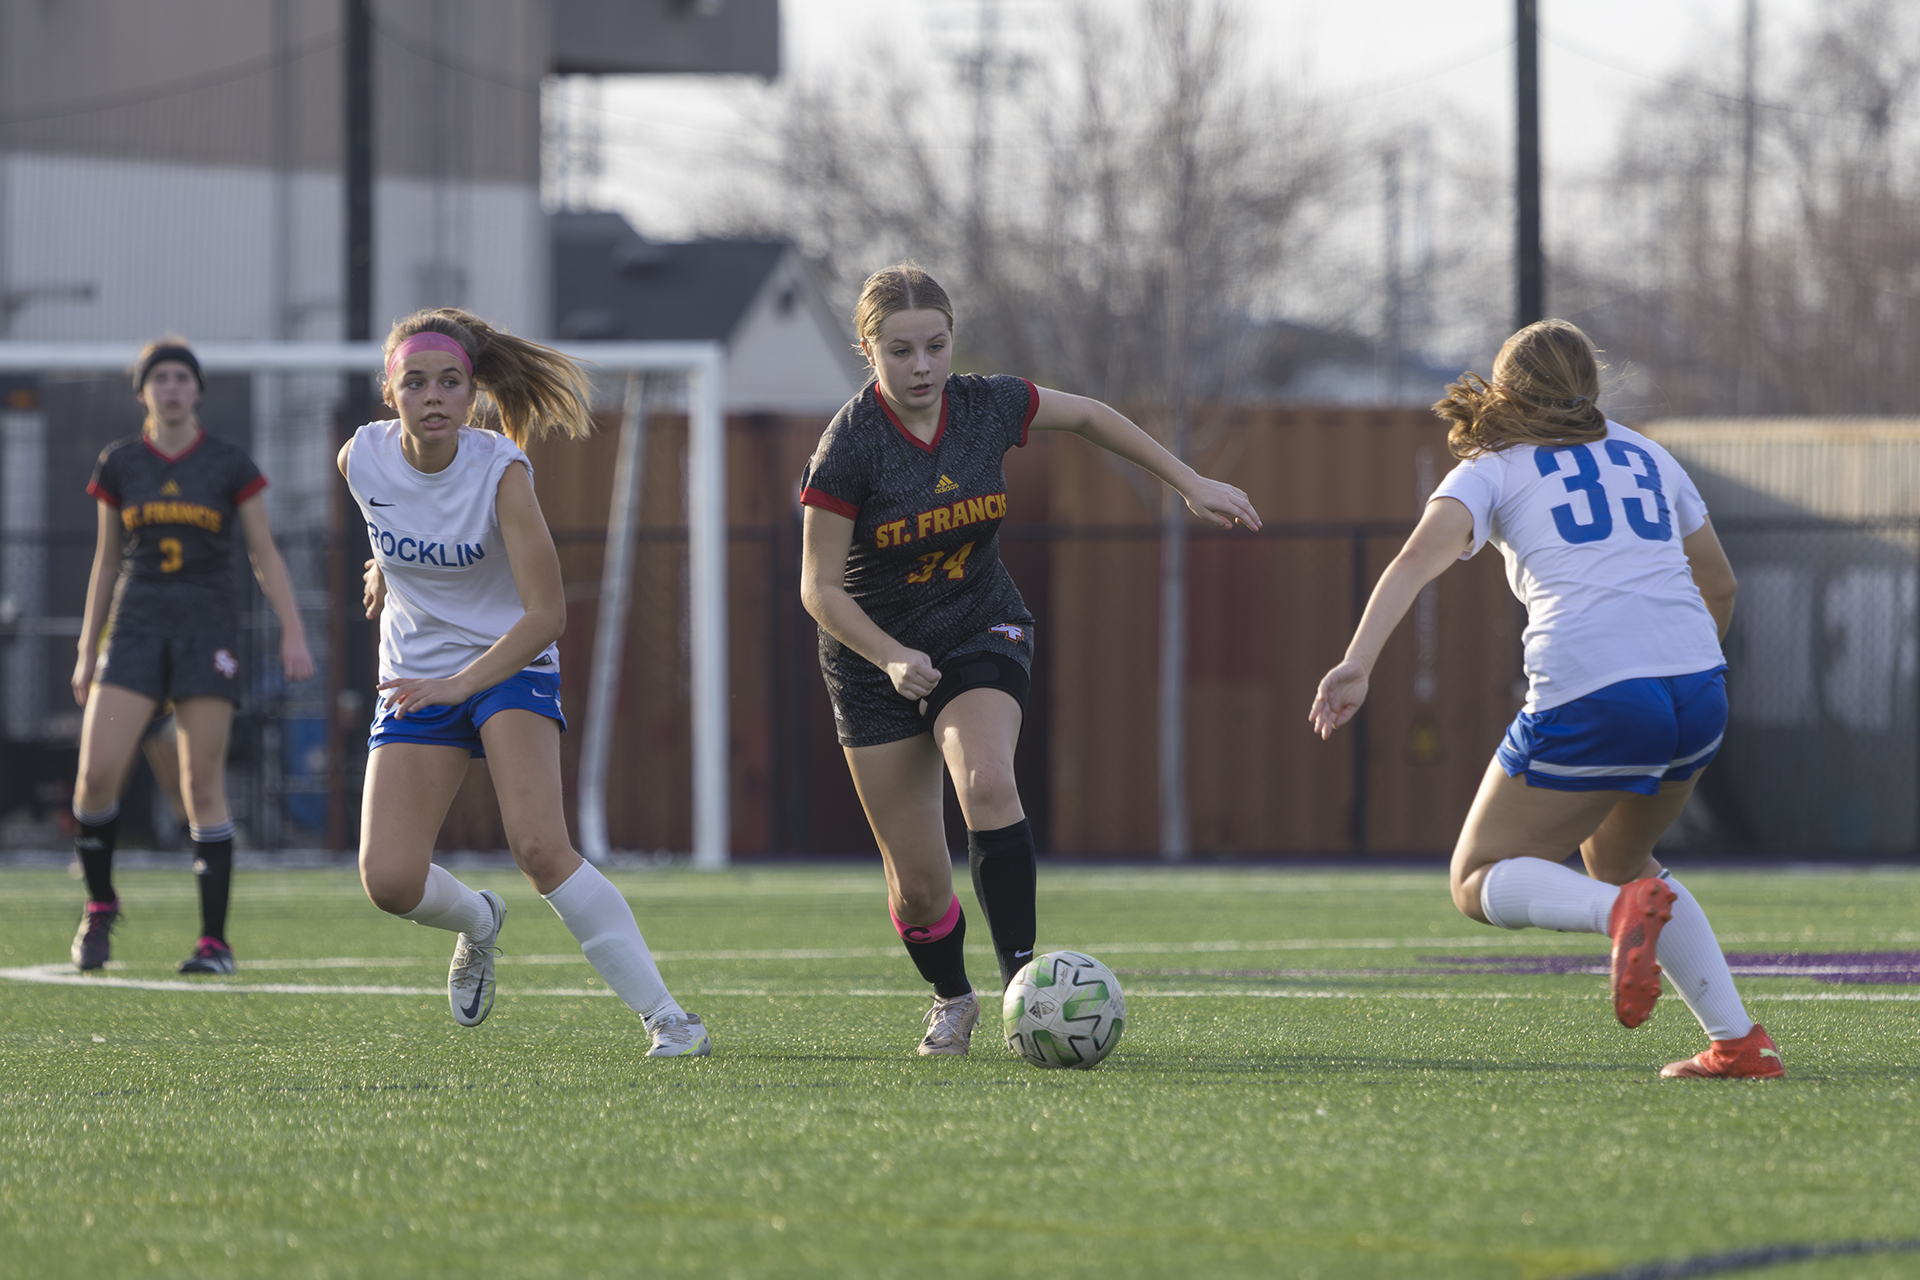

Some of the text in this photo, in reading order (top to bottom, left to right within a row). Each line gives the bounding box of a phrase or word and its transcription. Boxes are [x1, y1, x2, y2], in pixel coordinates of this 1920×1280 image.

[935, 483, 960, 494] adidas
[1534, 439, 1672, 544] 33
[875, 491, 1006, 549] ST. FRANCIS
[159, 537, 183, 573] 3
[368, 521, 485, 567] ROCKLIN
[907, 541, 976, 584] 34
